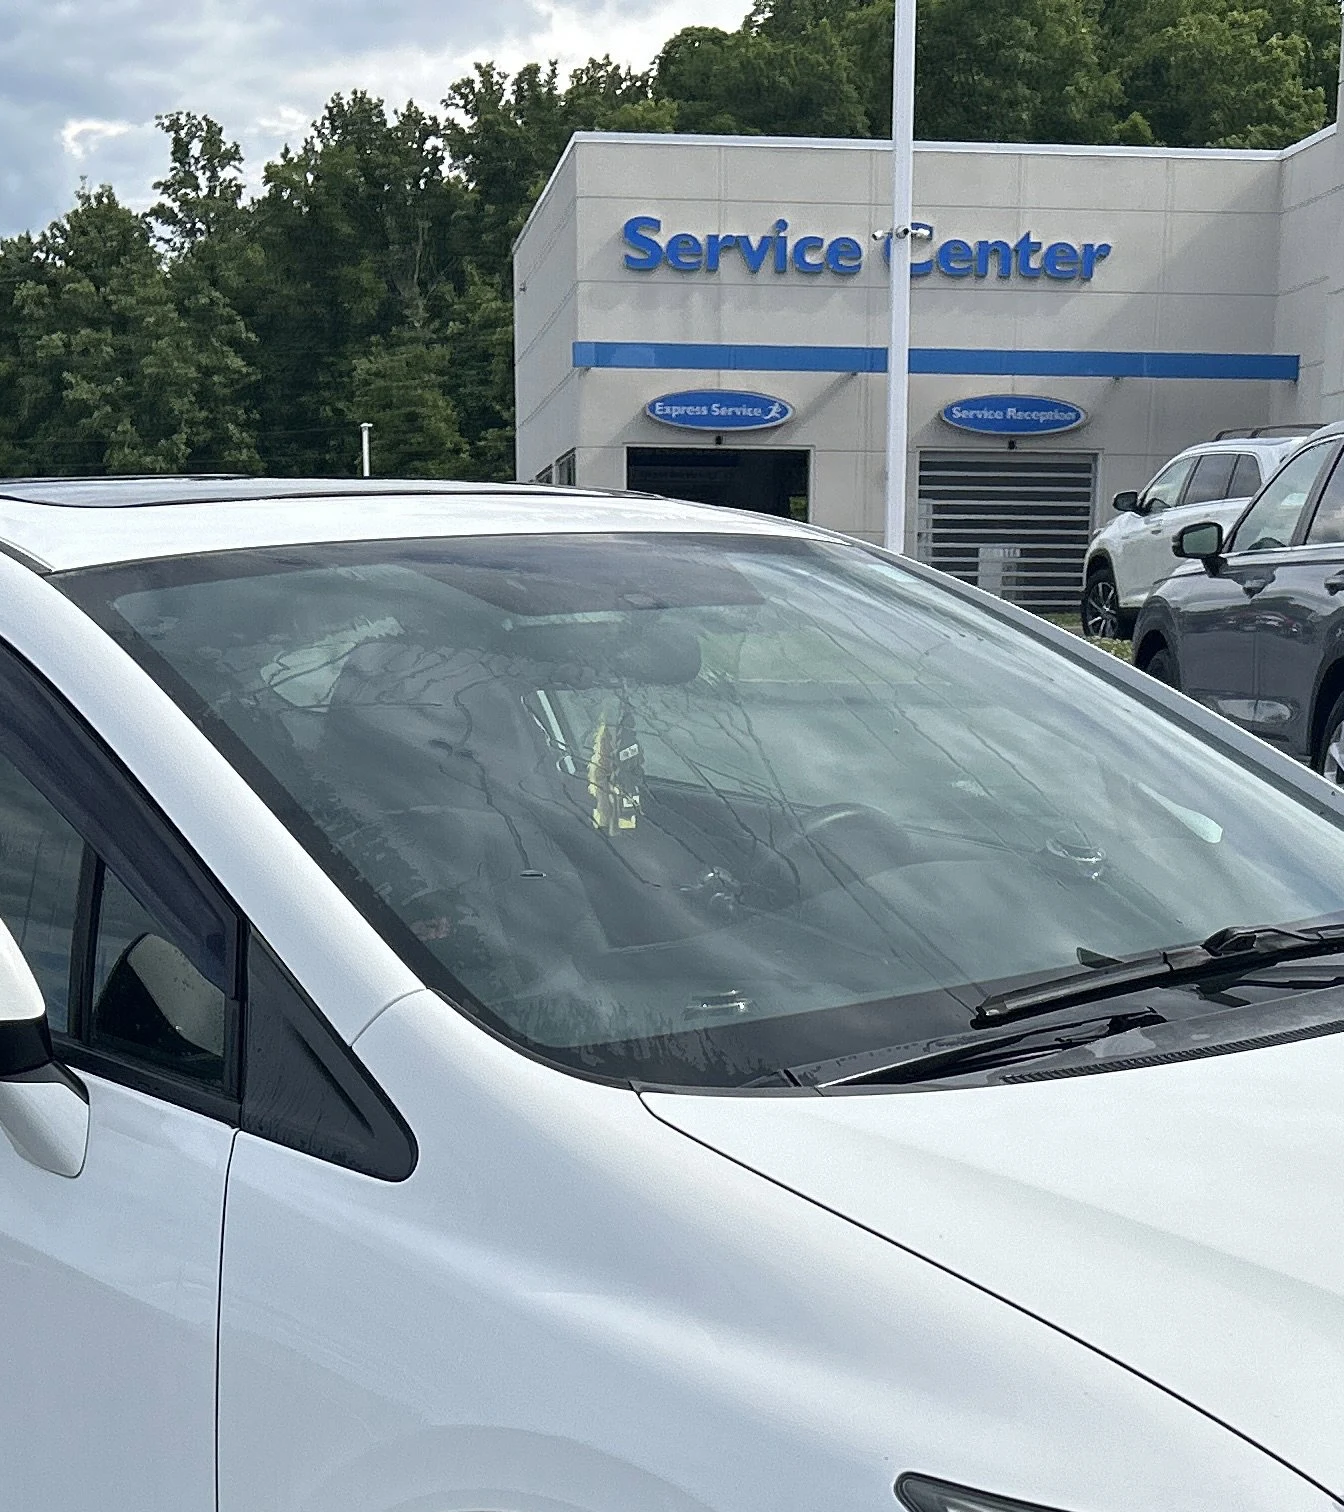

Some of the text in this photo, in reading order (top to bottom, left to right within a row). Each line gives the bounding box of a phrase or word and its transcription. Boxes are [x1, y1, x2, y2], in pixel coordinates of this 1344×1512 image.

[622, 216, 863, 274] Service
[655, 402, 762, 418] Express Service
[951, 406, 1076, 423] Service Reception
